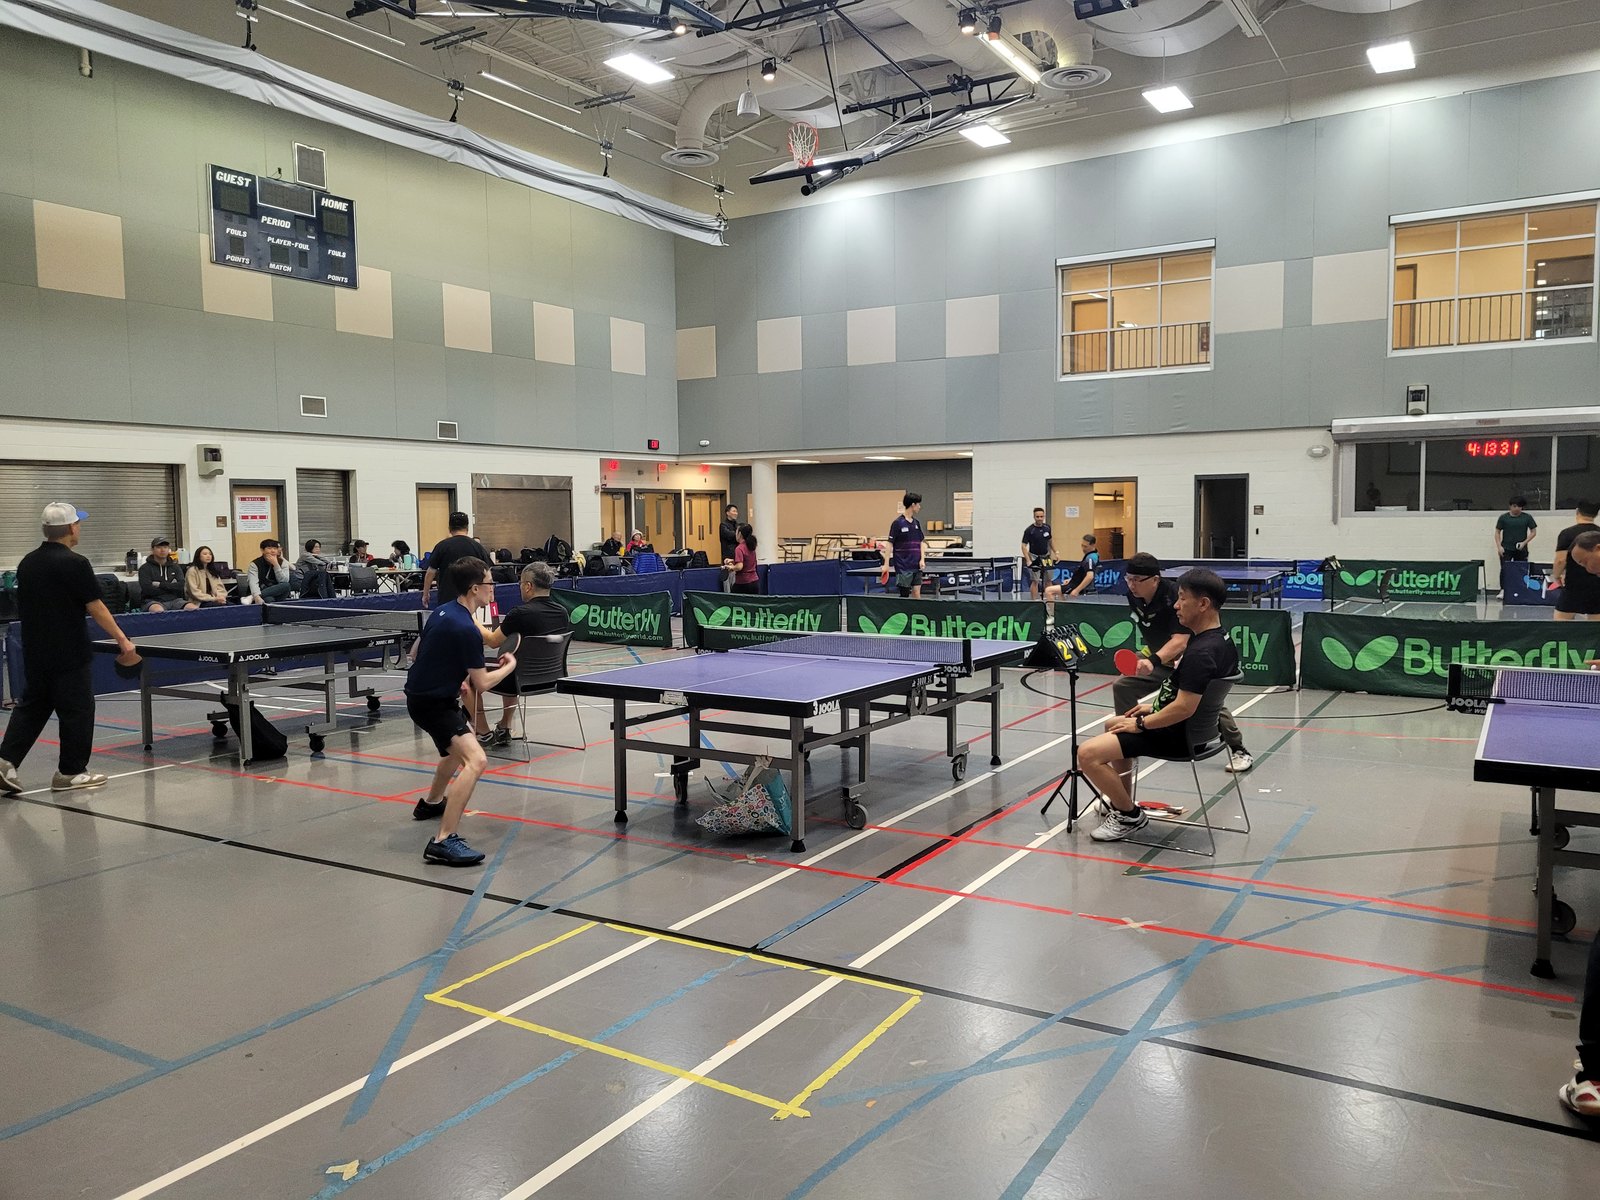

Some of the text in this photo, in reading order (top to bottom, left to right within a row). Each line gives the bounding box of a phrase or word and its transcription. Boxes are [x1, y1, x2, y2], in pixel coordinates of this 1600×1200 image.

[215, 171, 252, 188] GUEST
[321, 198, 349, 212] HOME
[261, 215, 291, 229] PERIOD
[226, 227, 248, 238] FOULS
[267, 236, 310, 251] PLAYER-FOUL
[225, 254, 250, 265] POINTS
[327, 249, 347, 258] FOULS
[269, 263, 292, 273] MATCH
[327, 274, 349, 283] POINTS
[588, 604, 661, 635] Butterfly
[731, 606, 822, 632] Butterfly
[911, 613, 1032, 641] Butterfly
[1057, 641, 1073, 660] 2
[1075, 637, 1088, 654] 4
[244, 653, 270, 662] JOOLA
[1403, 637, 1596, 678] Butterfly
[944, 665, 968, 674] JOOLA
[812, 701, 819, 716] 3
[818, 699, 841, 715] JOOLA
[1451, 697, 1487, 708] JOOLA
